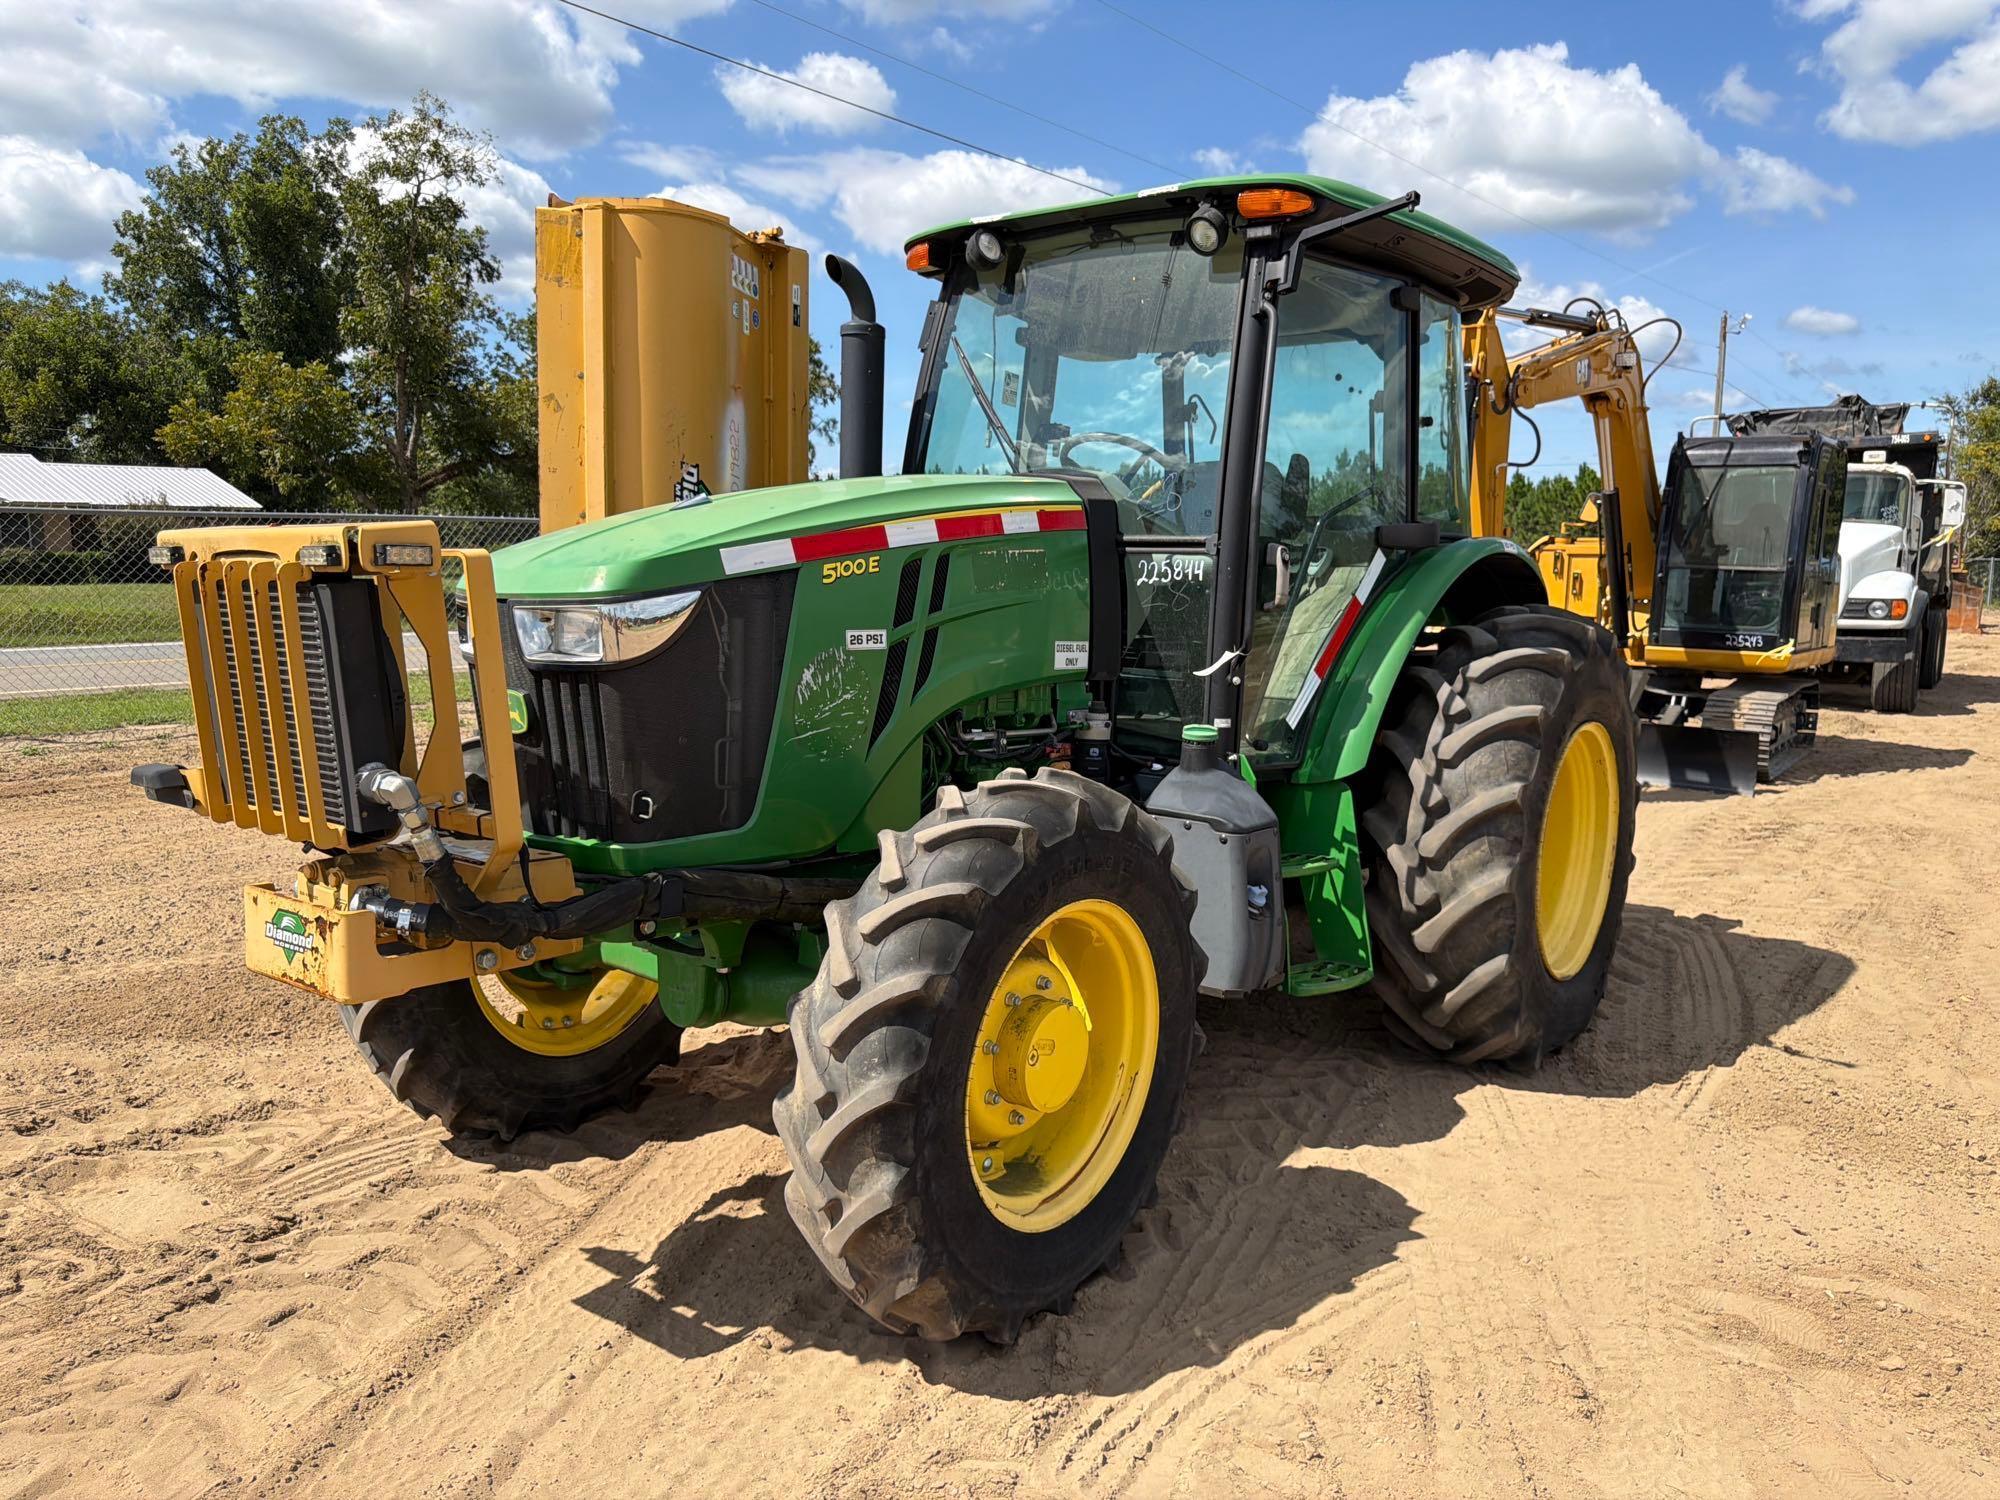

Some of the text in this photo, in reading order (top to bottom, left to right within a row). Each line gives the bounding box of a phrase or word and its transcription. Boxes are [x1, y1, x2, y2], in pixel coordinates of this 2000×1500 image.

[1576, 359, 1588, 384] CAT
[1136, 559, 1205, 586] 225844
[850, 633, 884, 645] 26 PSI
[1725, 633, 1764, 648] 225243
[1056, 644, 1088, 653] DIESEL FUEL
[1065, 657, 1079, 667] ONLY
[265, 922, 313, 949] Diamond
